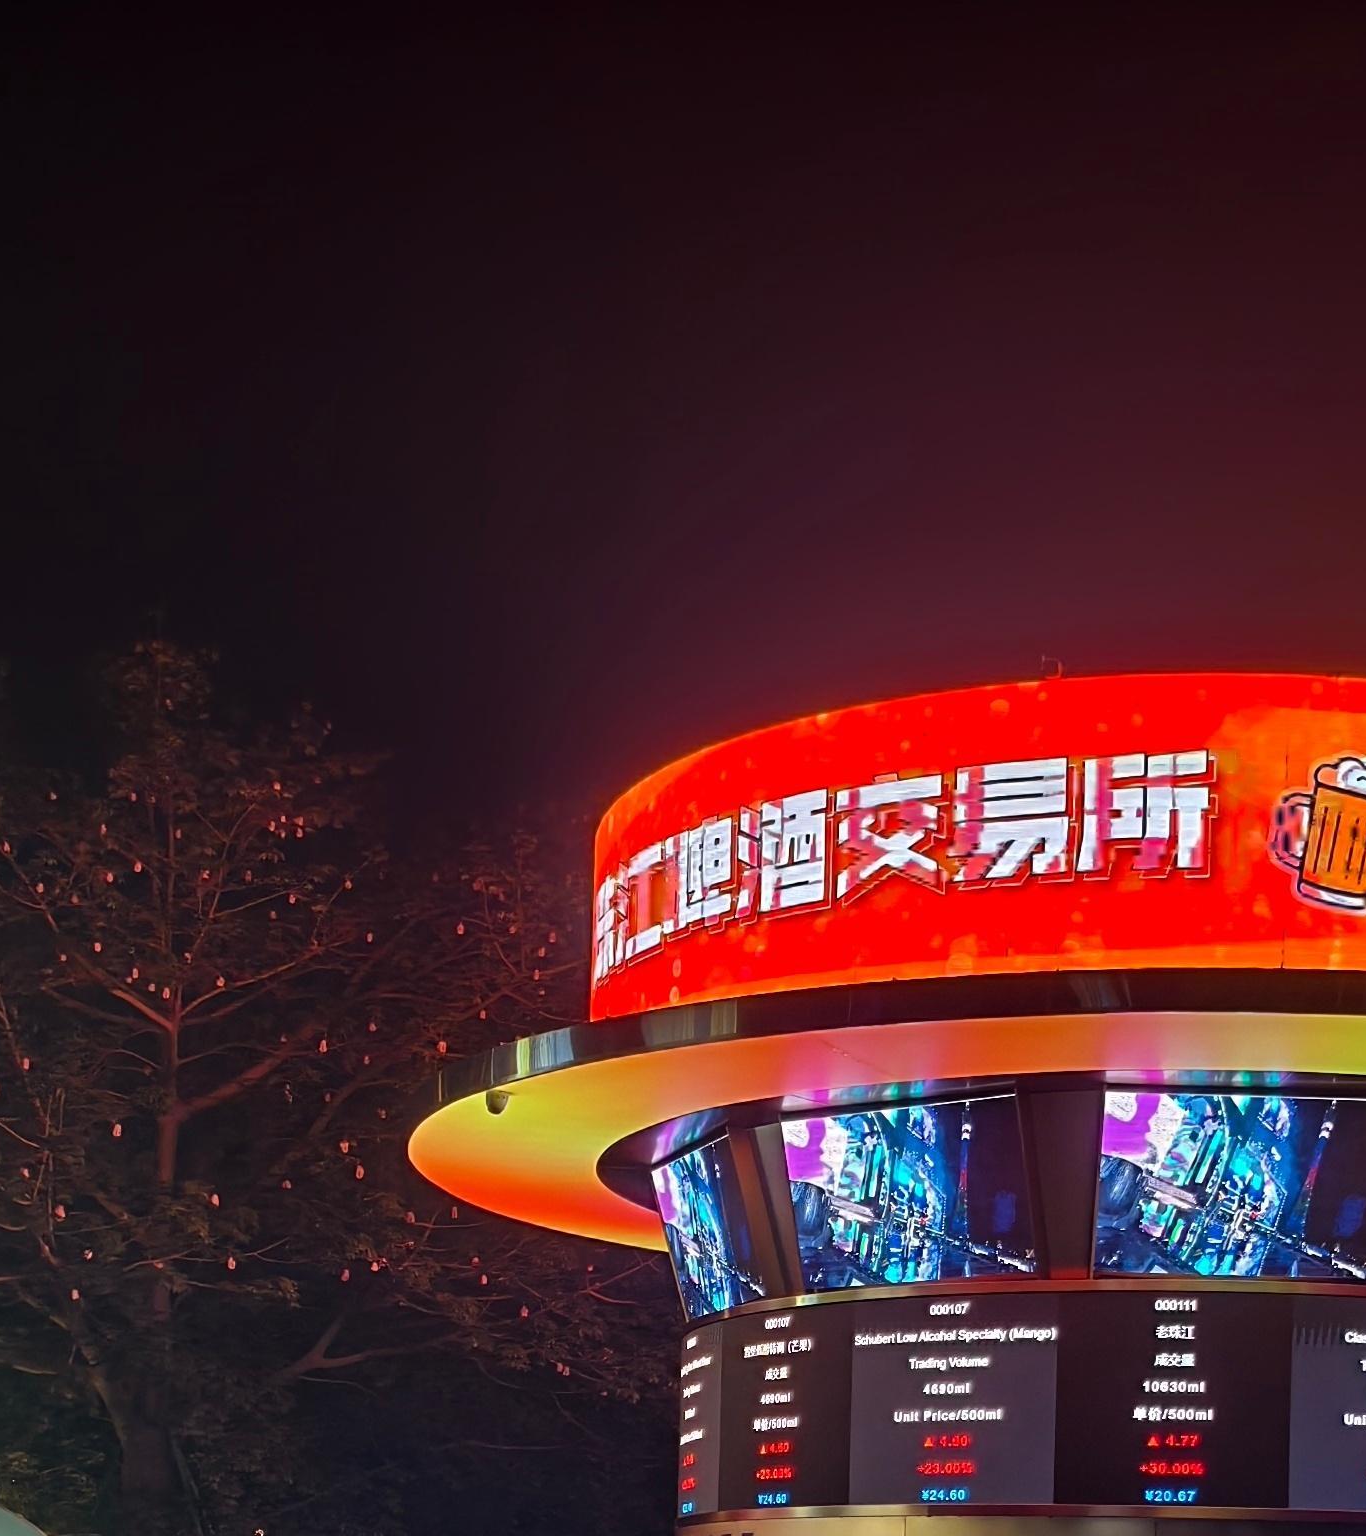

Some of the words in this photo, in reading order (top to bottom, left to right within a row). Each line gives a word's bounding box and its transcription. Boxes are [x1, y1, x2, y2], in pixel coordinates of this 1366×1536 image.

[930, 1303, 970, 1316] 000107
[1154, 1299, 1197, 1311] 000111
[896, 1332, 917, 1344] Low
[918, 1330, 956, 1342] Alcohol
[1008, 1326, 1056, 1342] (Mango)
[1155, 1325, 1195, 1339] 老珠江
[909, 1357, 946, 1370] Trading
[948, 1356, 988, 1368] Volume
[1154, 1353, 1195, 1367] 成交量
[893, 1411, 919, 1423] Unit
[923, 1408, 1002, 1422] Price/500ml
[1133, 1407, 1214, 1420] 单价/500ml
[921, 1489, 965, 1501] ¥24.60
[1145, 1490, 1196, 1502] ¥20.67
